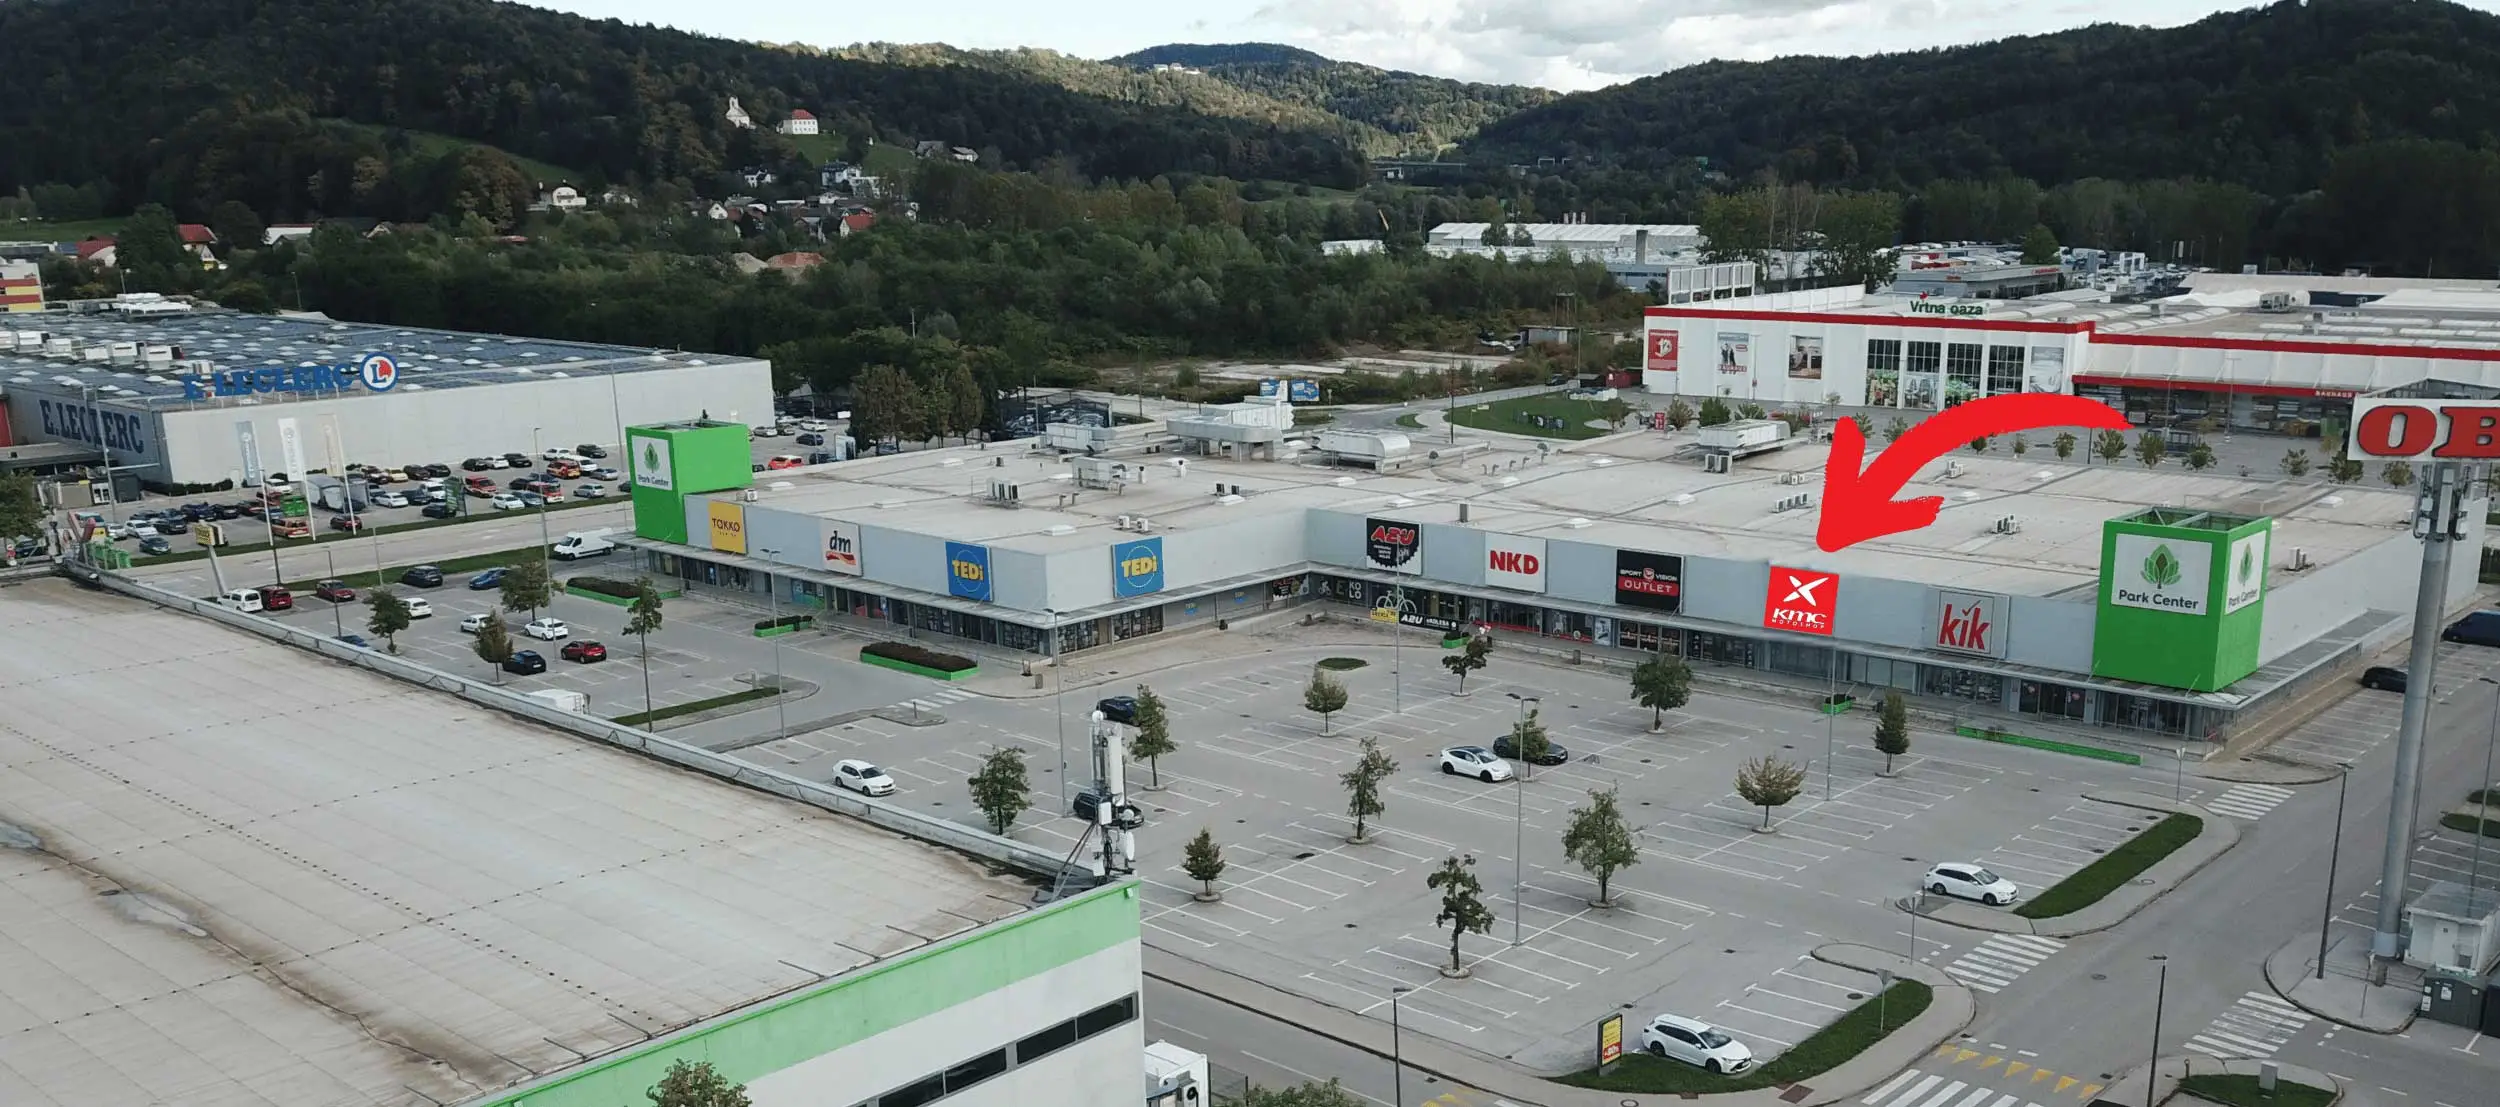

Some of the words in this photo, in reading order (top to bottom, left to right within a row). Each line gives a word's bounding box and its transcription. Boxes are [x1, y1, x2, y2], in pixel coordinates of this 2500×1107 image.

[1910, 301, 1945, 313] Vrtna
[1950, 304, 1983, 315] oaza
[181, 364, 355, 400] E.LECLERC
[39, 399, 144, 454] E.LECLERC
[829, 531, 851, 552] dm
[1489, 550, 1539, 575] NKD
[1620, 568, 1642, 577] SPORT
[1655, 573, 1678, 581] VISION
[1624, 579, 1673, 593] OUTLET
[2119, 589, 2149, 603] Park
[2153, 593, 2198, 609] Center
